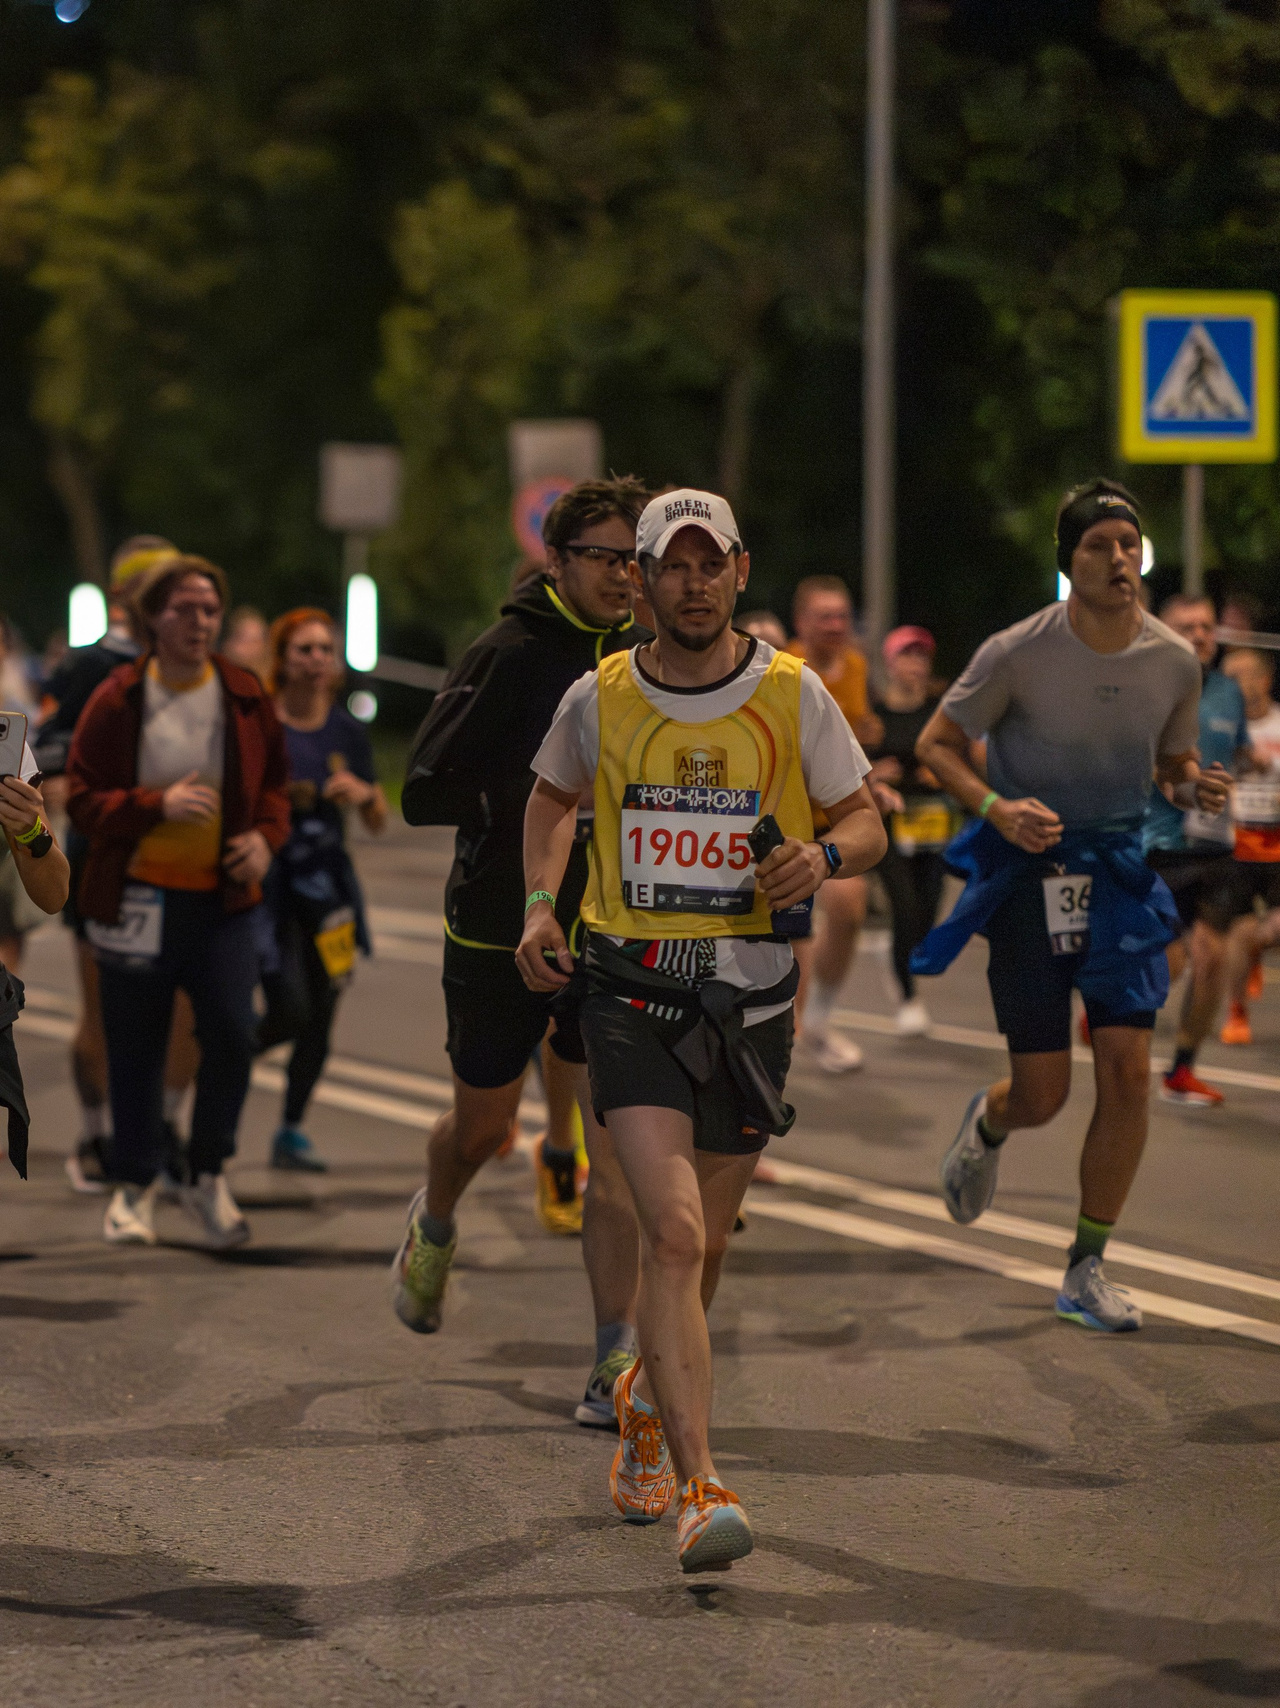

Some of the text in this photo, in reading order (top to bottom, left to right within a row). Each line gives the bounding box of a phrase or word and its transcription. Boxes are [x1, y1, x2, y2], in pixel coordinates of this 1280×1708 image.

[664, 499, 710, 513] GREAT
[665, 507, 712, 522] BRITAIN
[677, 755, 724, 776] Alpen
[681, 771, 720, 787] Gold
[628, 826, 751, 871] 19065
[637, 884, 649, 904] E
